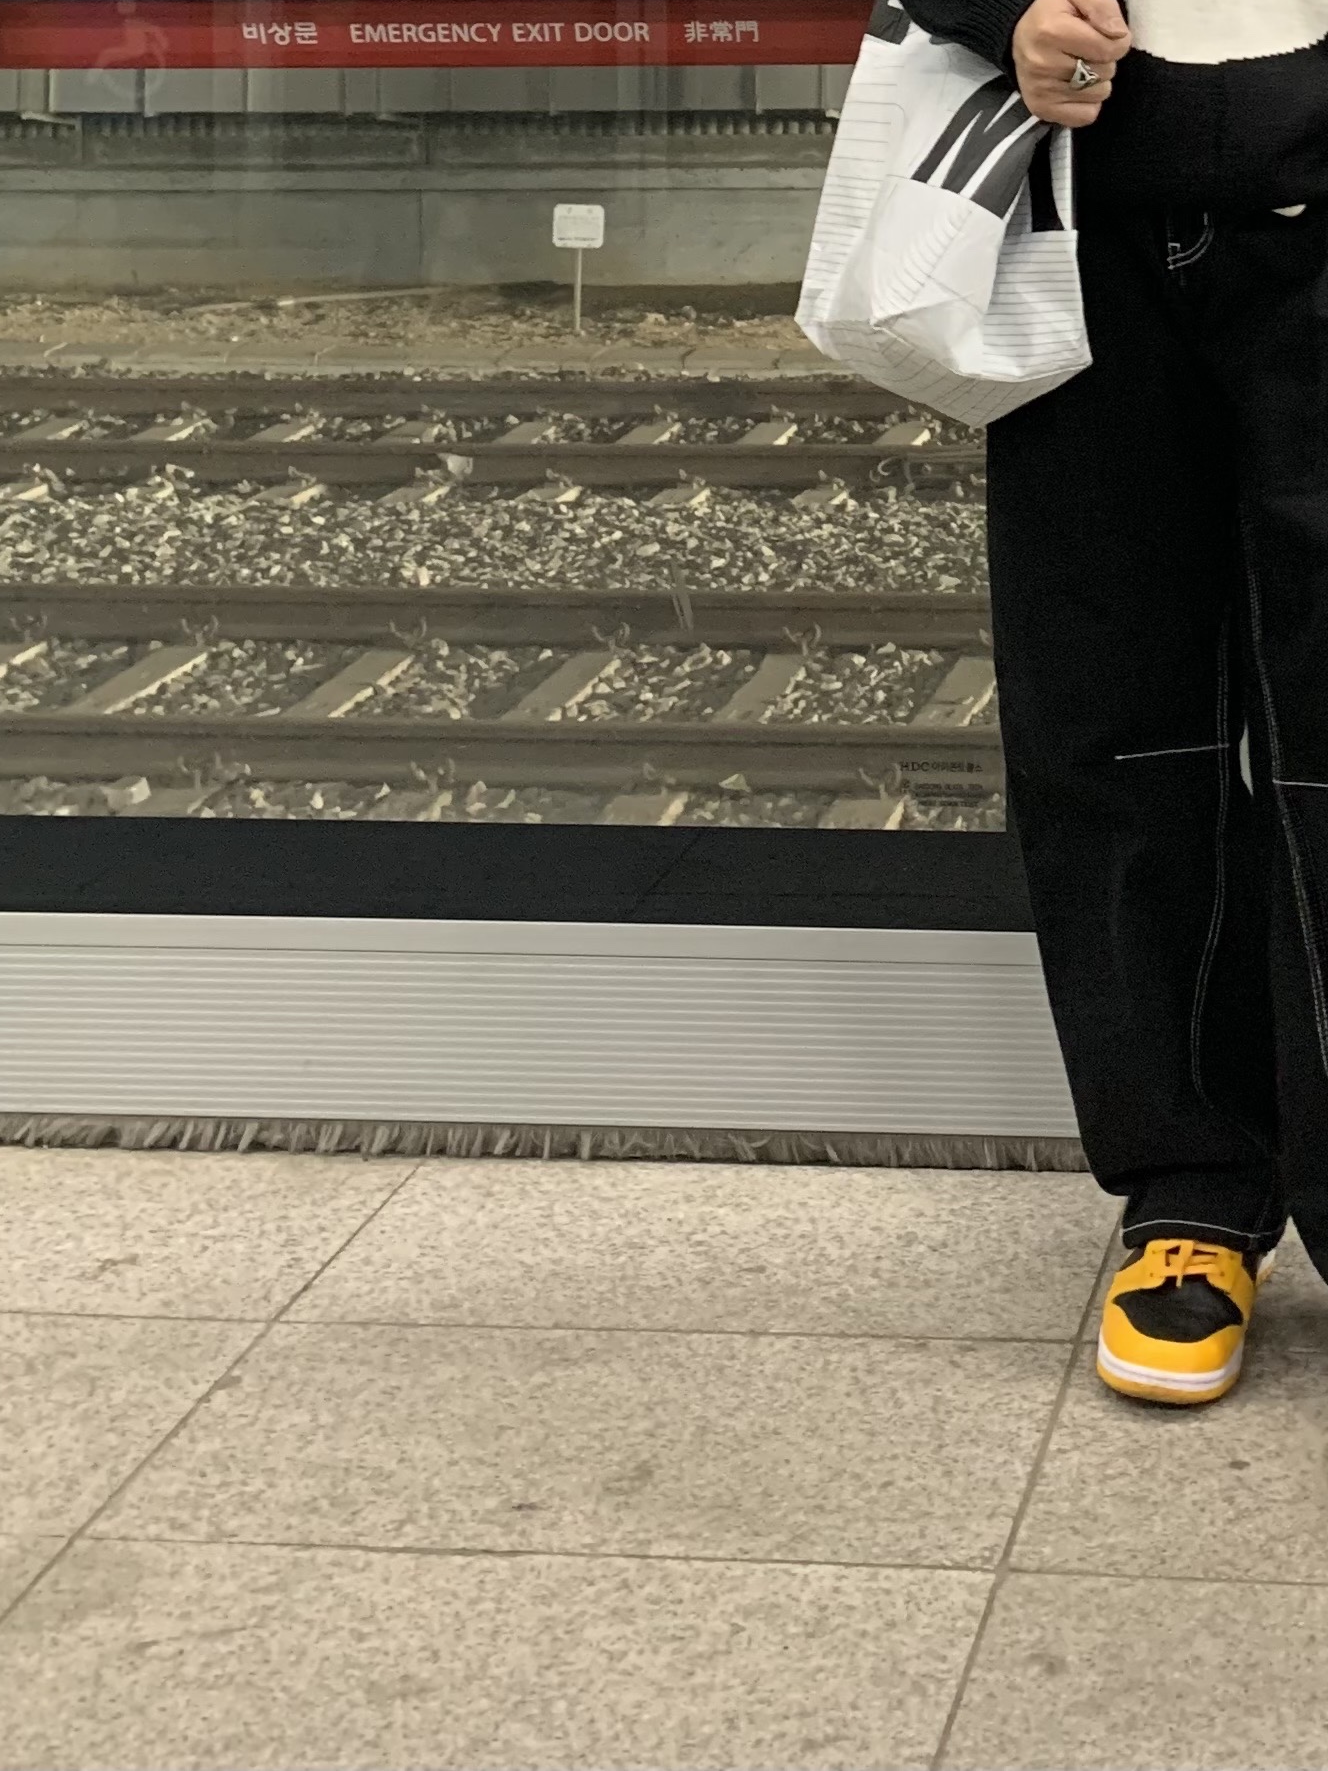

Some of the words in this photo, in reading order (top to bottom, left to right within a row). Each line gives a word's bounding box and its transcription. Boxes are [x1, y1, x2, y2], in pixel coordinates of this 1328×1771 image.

[242, 21, 318, 46] 비상문
[350, 22, 501, 43] EMERGENCY
[512, 21, 565, 43] EXIT
[575, 21, 650, 43] DOOR
[684, 20, 759, 44] 非常門
